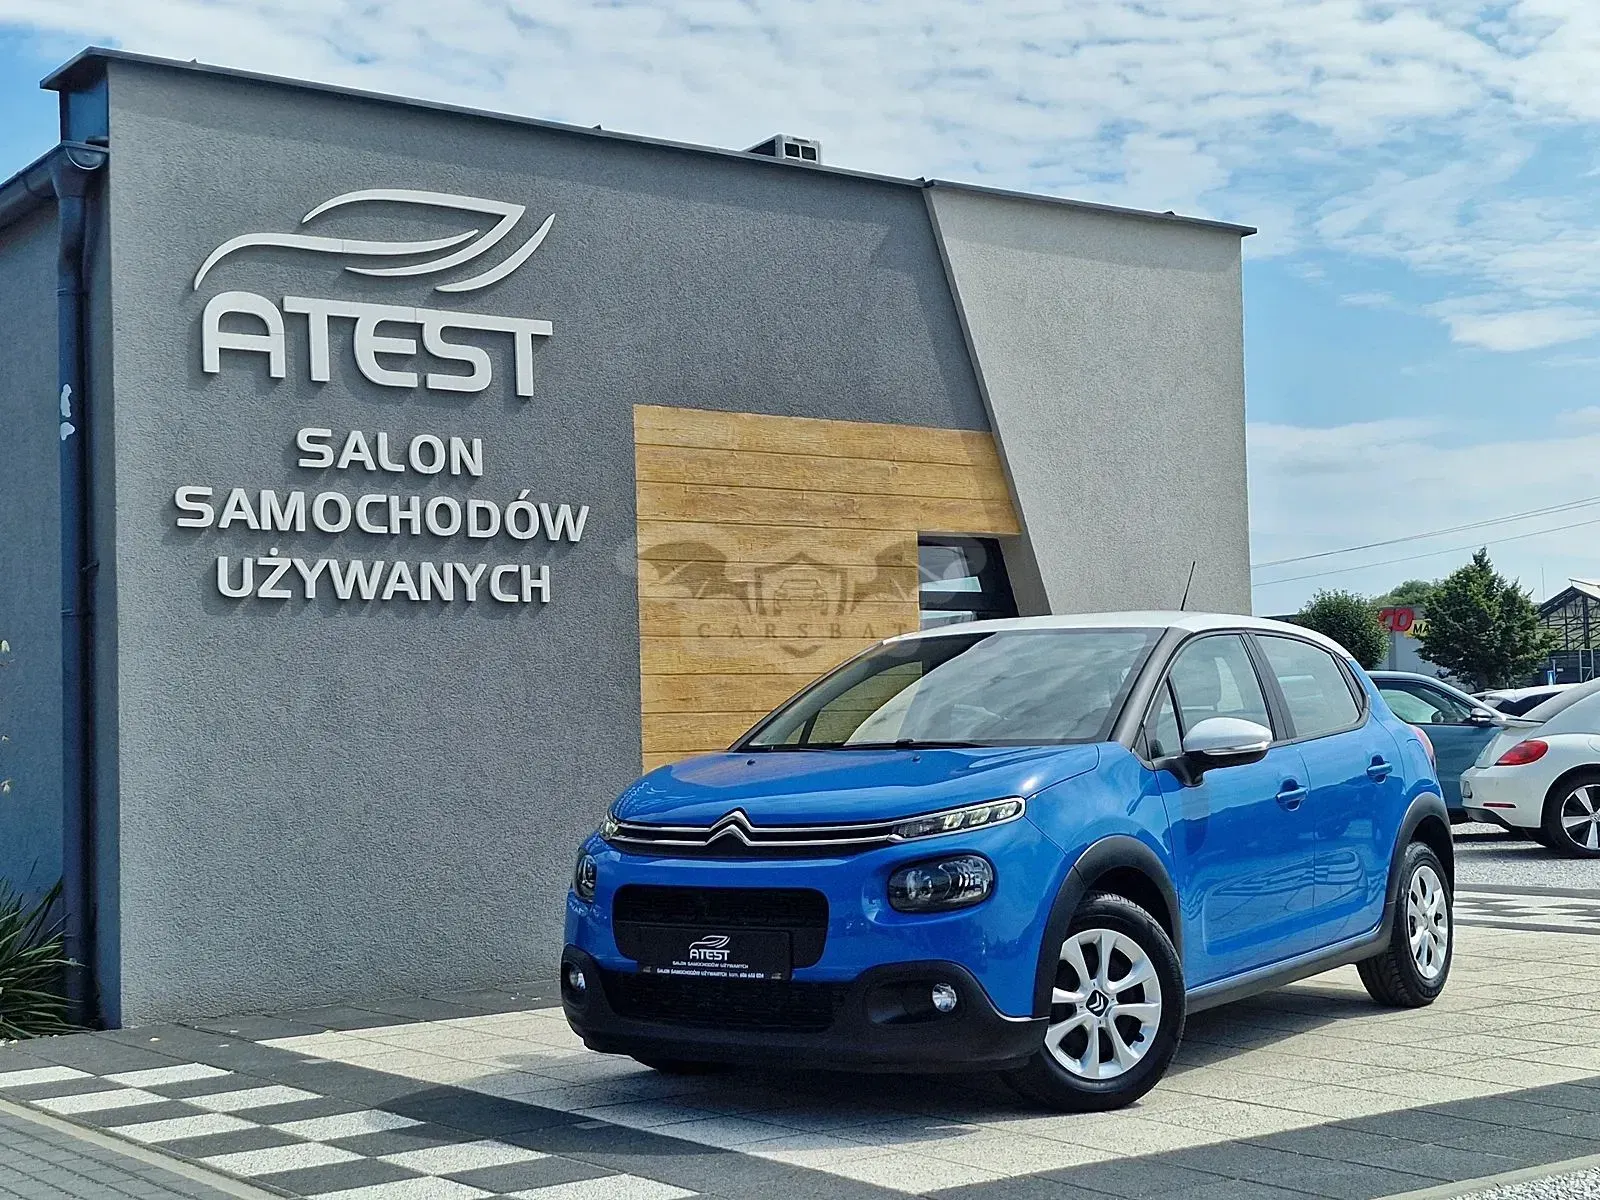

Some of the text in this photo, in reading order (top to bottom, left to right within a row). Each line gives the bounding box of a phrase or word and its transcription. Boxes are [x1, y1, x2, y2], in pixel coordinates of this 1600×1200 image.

[202, 291, 553, 397] ATEST
[297, 428, 483, 476] SALON
[175, 486, 590, 542] SAMOCHODÓW
[217, 547, 551, 603] UŻYWANYCH
[689, 949, 730, 961] ATEST
